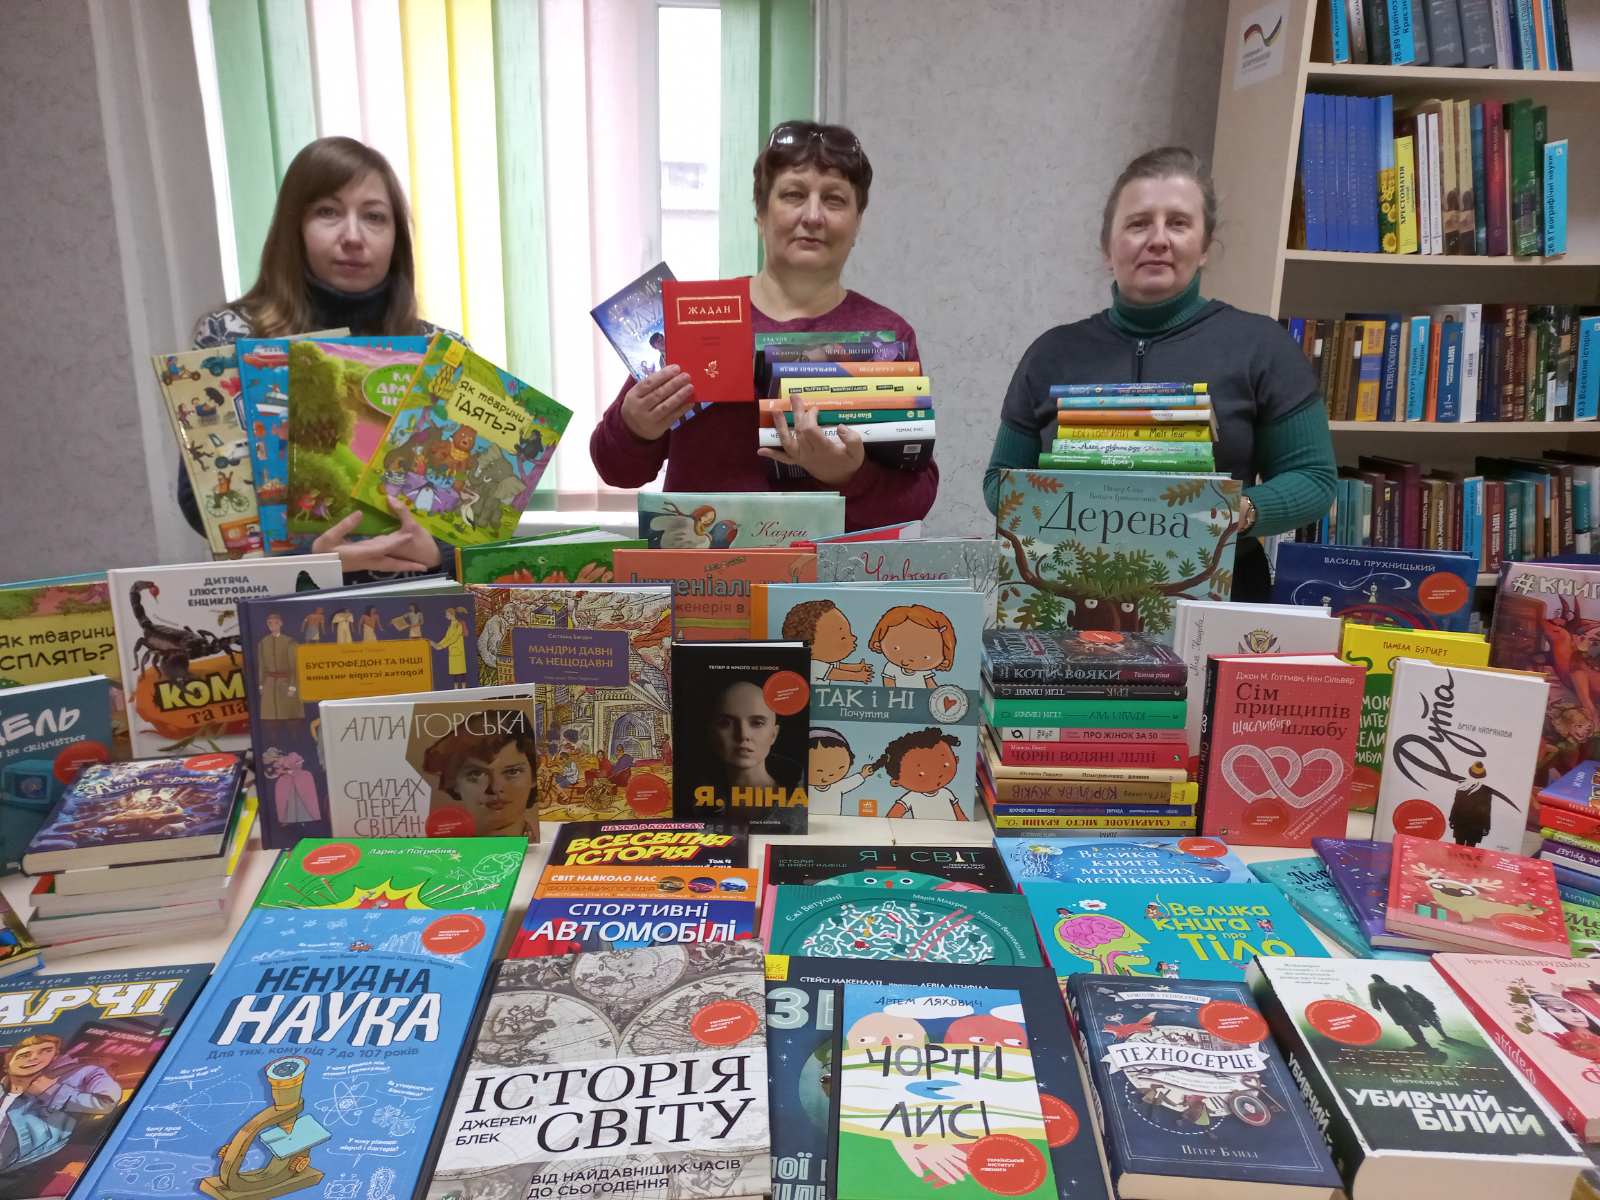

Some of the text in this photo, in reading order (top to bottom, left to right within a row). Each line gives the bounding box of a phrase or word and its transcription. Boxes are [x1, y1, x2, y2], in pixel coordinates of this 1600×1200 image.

[1398, 165, 1407, 226] ХРЕСТОМАТІЯ
[688, 304, 732, 316] ЖАДАН
[457, 378, 527, 424] Як тварини
[453, 391, 518, 437] ЇДЯТЬ?
[1039, 491, 1192, 545] Дерева
[751, 520, 808, 543] Казки
[1323, 556, 1436, 573] ВАСИЛЬ ПРУХНИЦЬКИЙ
[188, 584, 270, 597] ІЛЮСТРОВАНА
[203, 575, 250, 588] ДИТЯЧА
[0, 625, 116, 650] Як тварини
[0, 643, 115, 672] СПЛЯТЬ?
[527, 644, 614, 658] МАНДРИ ДАВНІ
[1383, 640, 1449, 657] ПАМЕЛА БУТЧАРТ
[305, 657, 383, 671] БУСТРОФЕДОН
[383, 657, 398, 666] ТА
[527, 655, 614, 669] ТА НЕЩОДАВНІ
[1235, 671, 1259, 681] Джон
[815, 688, 866, 709] ТАК
[887, 690, 915, 710] НІ
[1235, 682, 1280, 701] Сім
[187, 707, 216, 725] та
[839, 708, 890, 720] Почуття
[1234, 702, 1351, 719] принципів
[340, 710, 525, 743] АЛЛА ГОРСЬКА
[1083, 731, 1104, 740] ПРО
[1104, 731, 1134, 740] ЖІНОК
[1135, 732, 1148, 740] ЗА
[1231, 716, 1292, 737] щасливого
[1280, 721, 1349, 740] шлюбу
[1393, 668, 1487, 792] Рута
[1012, 751, 1056, 763] ЧОРНІ
[1059, 752, 1116, 763] ВОДЯНІ
[343, 777, 427, 800] СПАЛАХ
[730, 786, 809, 809] НІНА
[1011, 784, 1053, 798] ЖУКІВ
[357, 794, 418, 818] ПЕРЕД
[600, 824, 638, 832] НАУКА
[647, 822, 706, 831] КОМІКСАХ
[1065, 818, 1099, 827] МІСТО
[565, 832, 737, 853] ВСЕСВІТНЯ
[564, 845, 701, 866] ІСТОРІЯ
[859, 850, 878, 862] Я
[910, 850, 983, 863] СВІТ
[1078, 849, 1161, 859] Велика
[1090, 859, 1161, 867] книга
[1074, 876, 1215, 884] мешканців
[1080, 868, 1197, 877] морських
[911, 893, 936, 903] Марія
[568, 902, 709, 918] СПОРТИВНІ
[1167, 901, 1271, 918] Велика
[529, 919, 737, 943] АВТОМОБІЛІ
[1150, 914, 1255, 933] книга
[1221, 931, 1248, 941] про
[1177, 933, 1296, 961] Тіло
[254, 965, 433, 993] НЕНУДНА
[800, 976, 831, 984] СТЕЙСІ
[874, 995, 983, 1009] АРТЕМ ЛЯХОВИЧ
[208, 992, 441, 1047] НАУКА
[206, 1047, 236, 1061] Для
[239, 1048, 267, 1058] тих,
[268, 1046, 303, 1057] кому
[336, 1049, 356, 1060] до
[359, 1049, 382, 1059] 107
[384, 1047, 420, 1060] років
[865, 1043, 1003, 1081] ЧОРТИ
[1115, 1045, 1258, 1070] ТЕХНОСЕРЦЕ
[465, 1055, 753, 1115] ІСТОРІЯ
[1345, 1087, 1502, 1113] УБИВЧИЙ
[458, 1115, 537, 1132] ДЖЕРЕМІ
[537, 1097, 757, 1153] СВІТУ
[879, 1100, 992, 1139] ЛИСІ
[1410, 1106, 1547, 1138] БІЛИЙ
[455, 1132, 500, 1147] БЛЕК
[530, 1158, 742, 1186] ВІД НАЙДАВНІШИХ ЧАСІВ
[526, 1177, 670, 1200] ДО СЬОГОДЕННЯ
